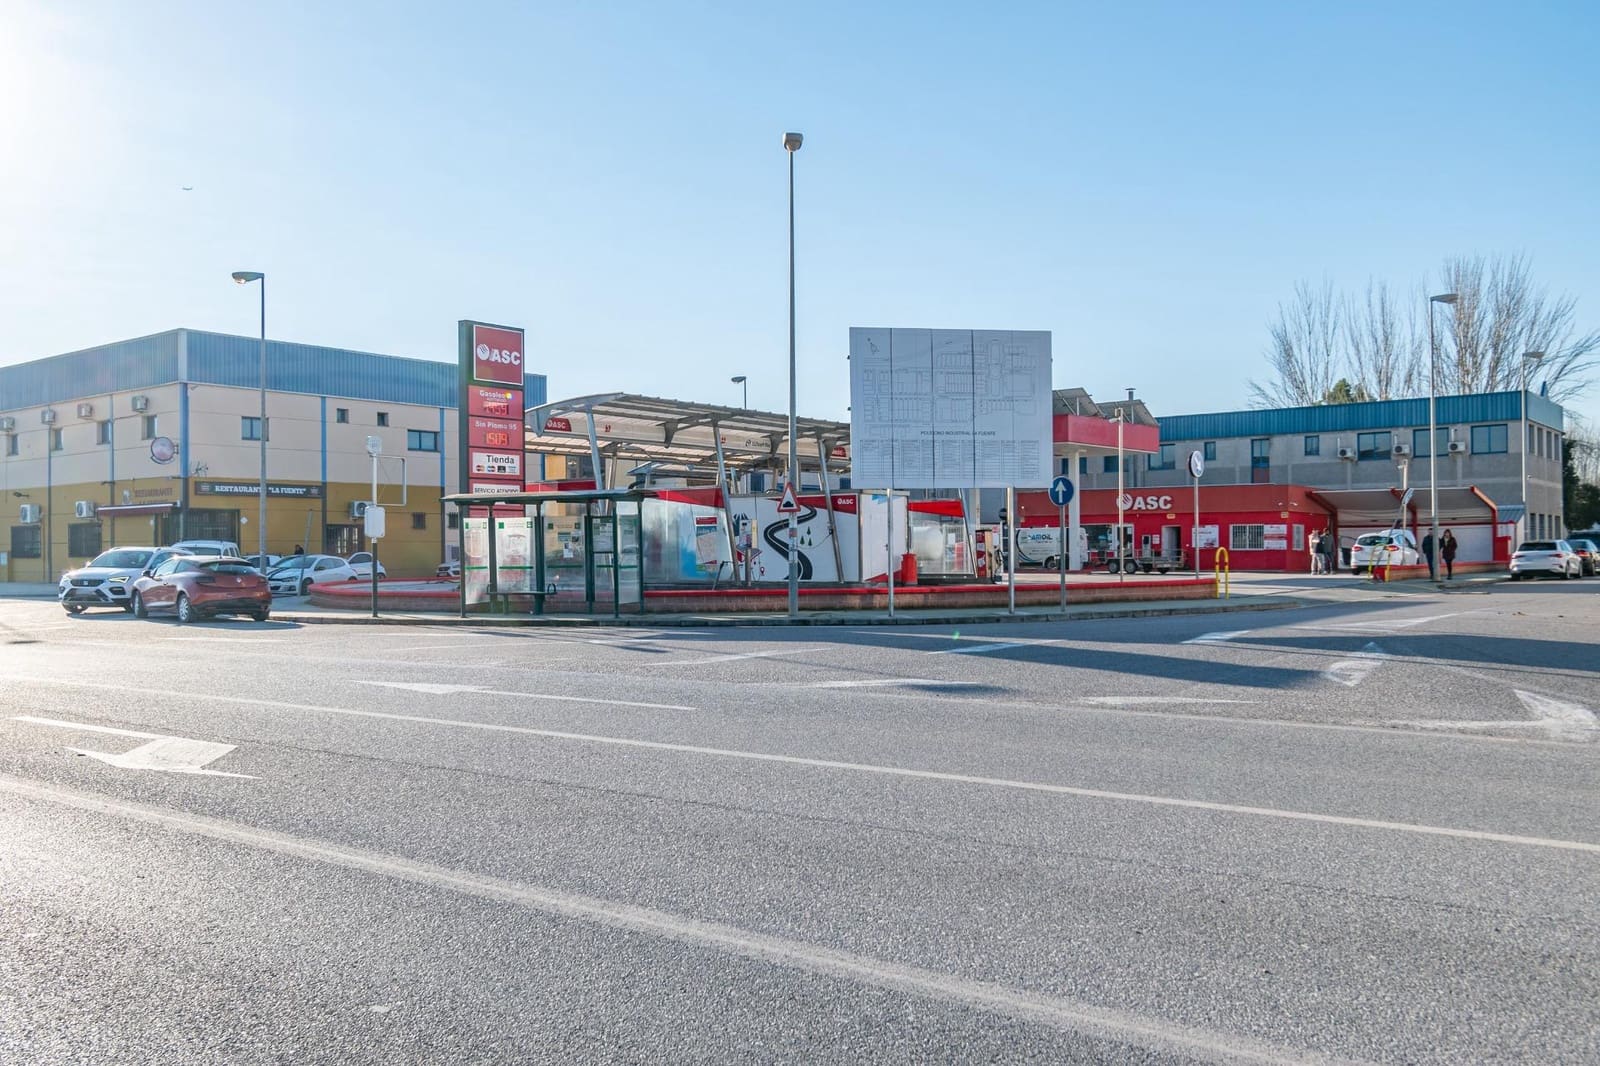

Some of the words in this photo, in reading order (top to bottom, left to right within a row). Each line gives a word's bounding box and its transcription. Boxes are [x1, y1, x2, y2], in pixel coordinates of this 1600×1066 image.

[490, 349, 521, 366] ASC
[553, 421, 566, 429] ASC
[486, 454, 515, 464] Tienda
[1132, 495, 1173, 510] ASC
